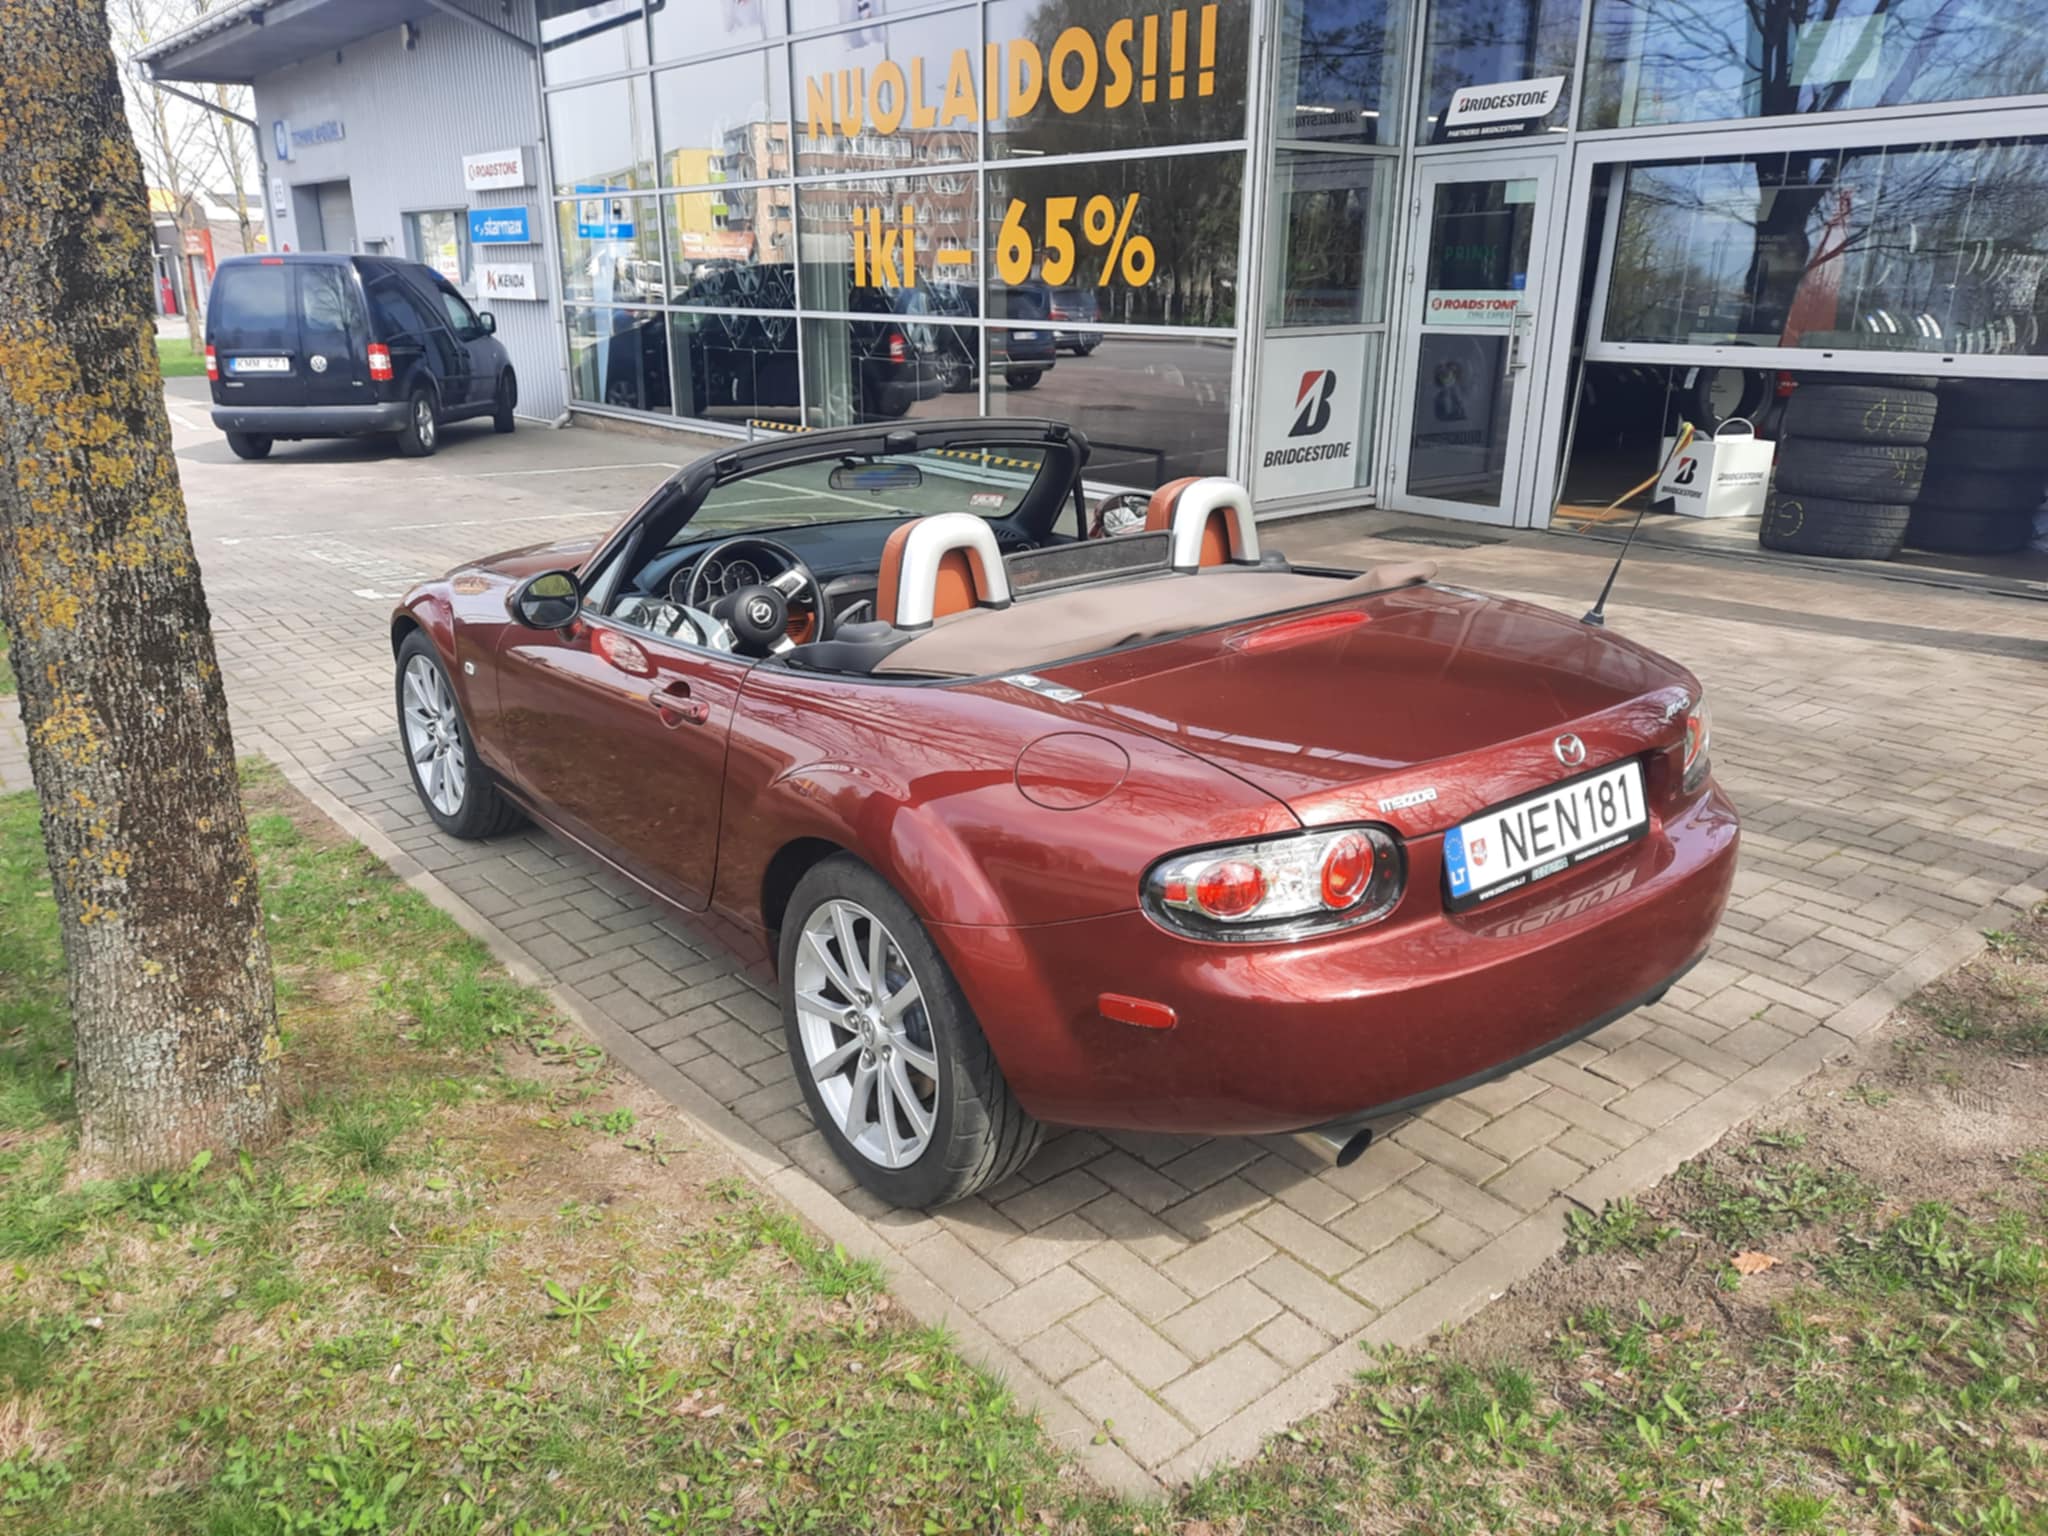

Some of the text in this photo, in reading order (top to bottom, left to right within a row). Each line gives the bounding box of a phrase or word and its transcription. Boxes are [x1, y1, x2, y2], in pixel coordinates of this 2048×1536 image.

[806, 4, 1217, 140] NUOLAIDOS!!!
[1459, 90, 1548, 112] BRIDGESTONE
[474, 161, 517, 177] ROADSTONE
[853, 205, 915, 288] iki
[997, 193, 1155, 287] 65%
[498, 274, 524, 288] KENDA
[1443, 299, 1518, 310] ROADSTONE
[237, 357, 287, 368] KMM 471
[1263, 441, 1351, 467] BRIDGESTONE
[1499, 773, 1631, 868] NEN181
[1451, 867, 1466, 886] LT
